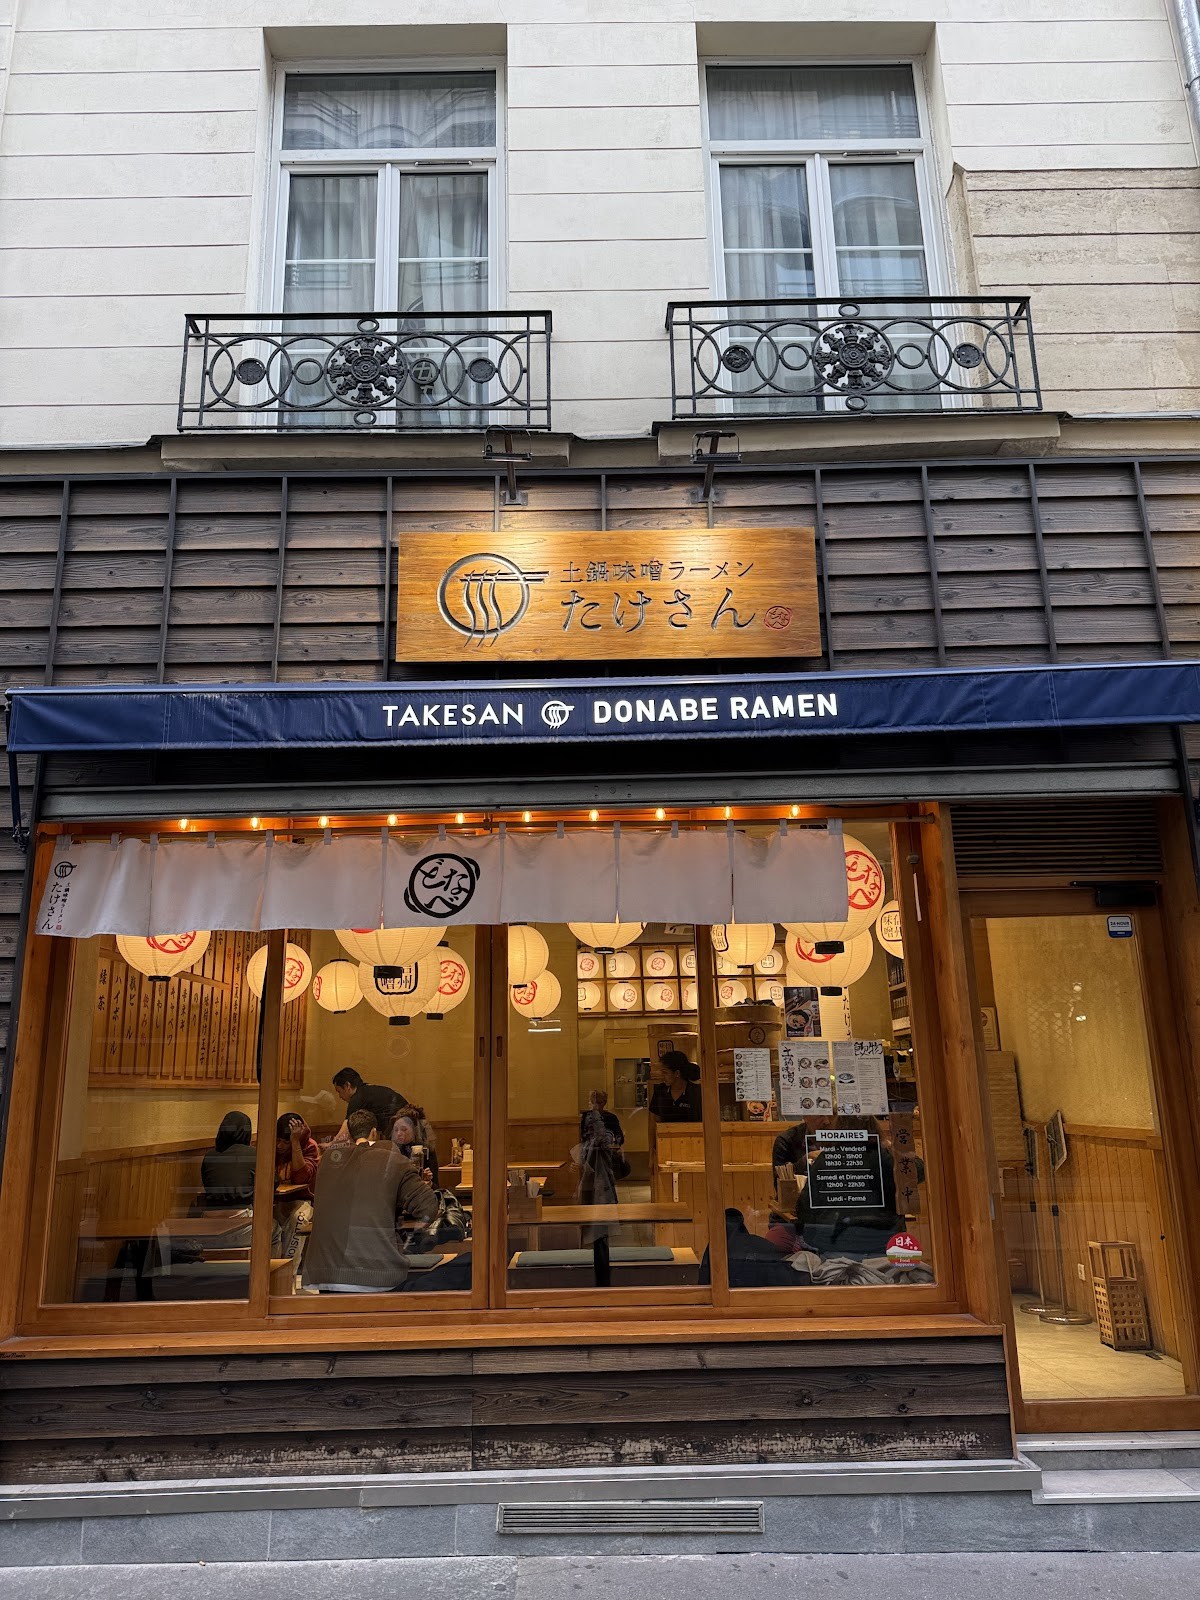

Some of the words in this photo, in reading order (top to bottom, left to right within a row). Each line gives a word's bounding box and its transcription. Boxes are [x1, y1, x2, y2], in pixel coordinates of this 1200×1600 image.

[560, 560, 754, 582] 土鍋味噌ラーメン
[561, 588, 756, 633] たけさん
[383, 703, 523, 727] TAKESAN
[593, 697, 719, 723] DONABE
[731, 694, 838, 720] RAMEN
[42, 882, 62, 929] たけさん
[896, 1128, 914, 1204] 営業中
[895, 1236, 914, 1247] 日本
